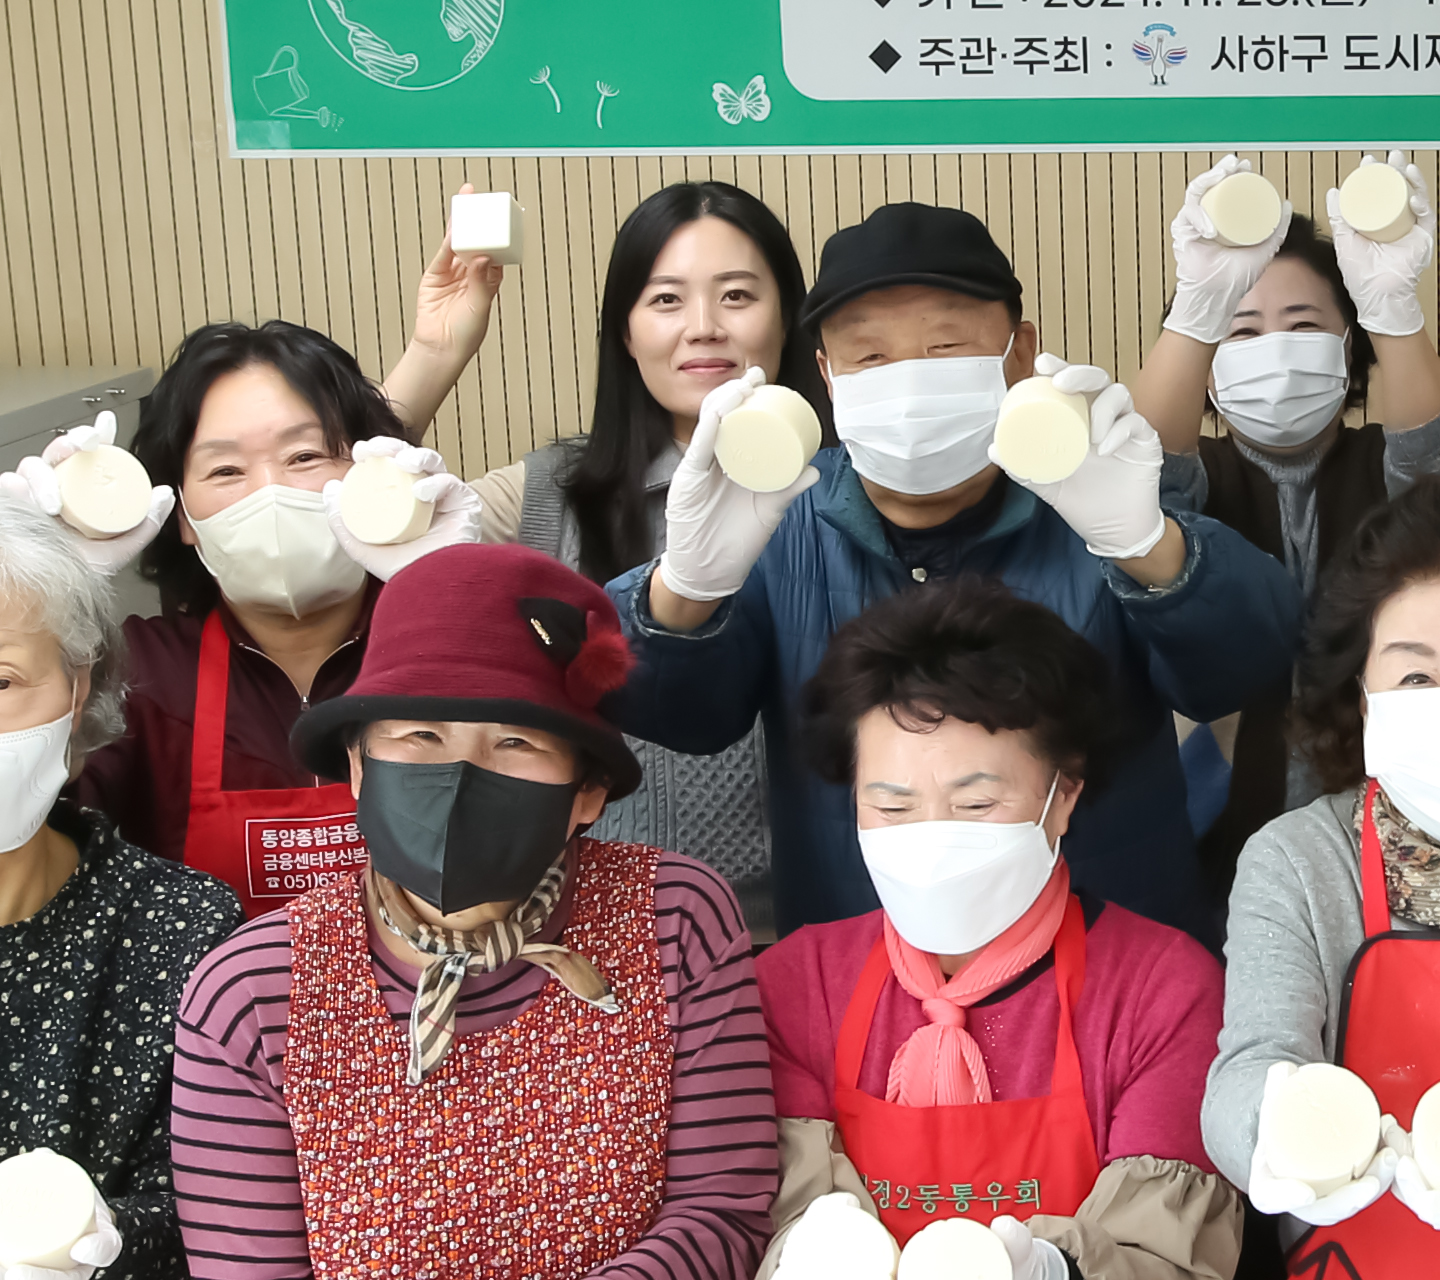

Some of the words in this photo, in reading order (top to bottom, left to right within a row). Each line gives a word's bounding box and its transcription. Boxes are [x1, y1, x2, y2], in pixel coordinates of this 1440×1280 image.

[919, 37, 1088, 75] 주관·주최
[1212, 34, 1328, 72] 사하구
[261, 823, 365, 849] 동양종합금융
[262, 846, 370, 872] 금융센터부산본
[860, 1173, 1041, 1214] 정2동통우회
